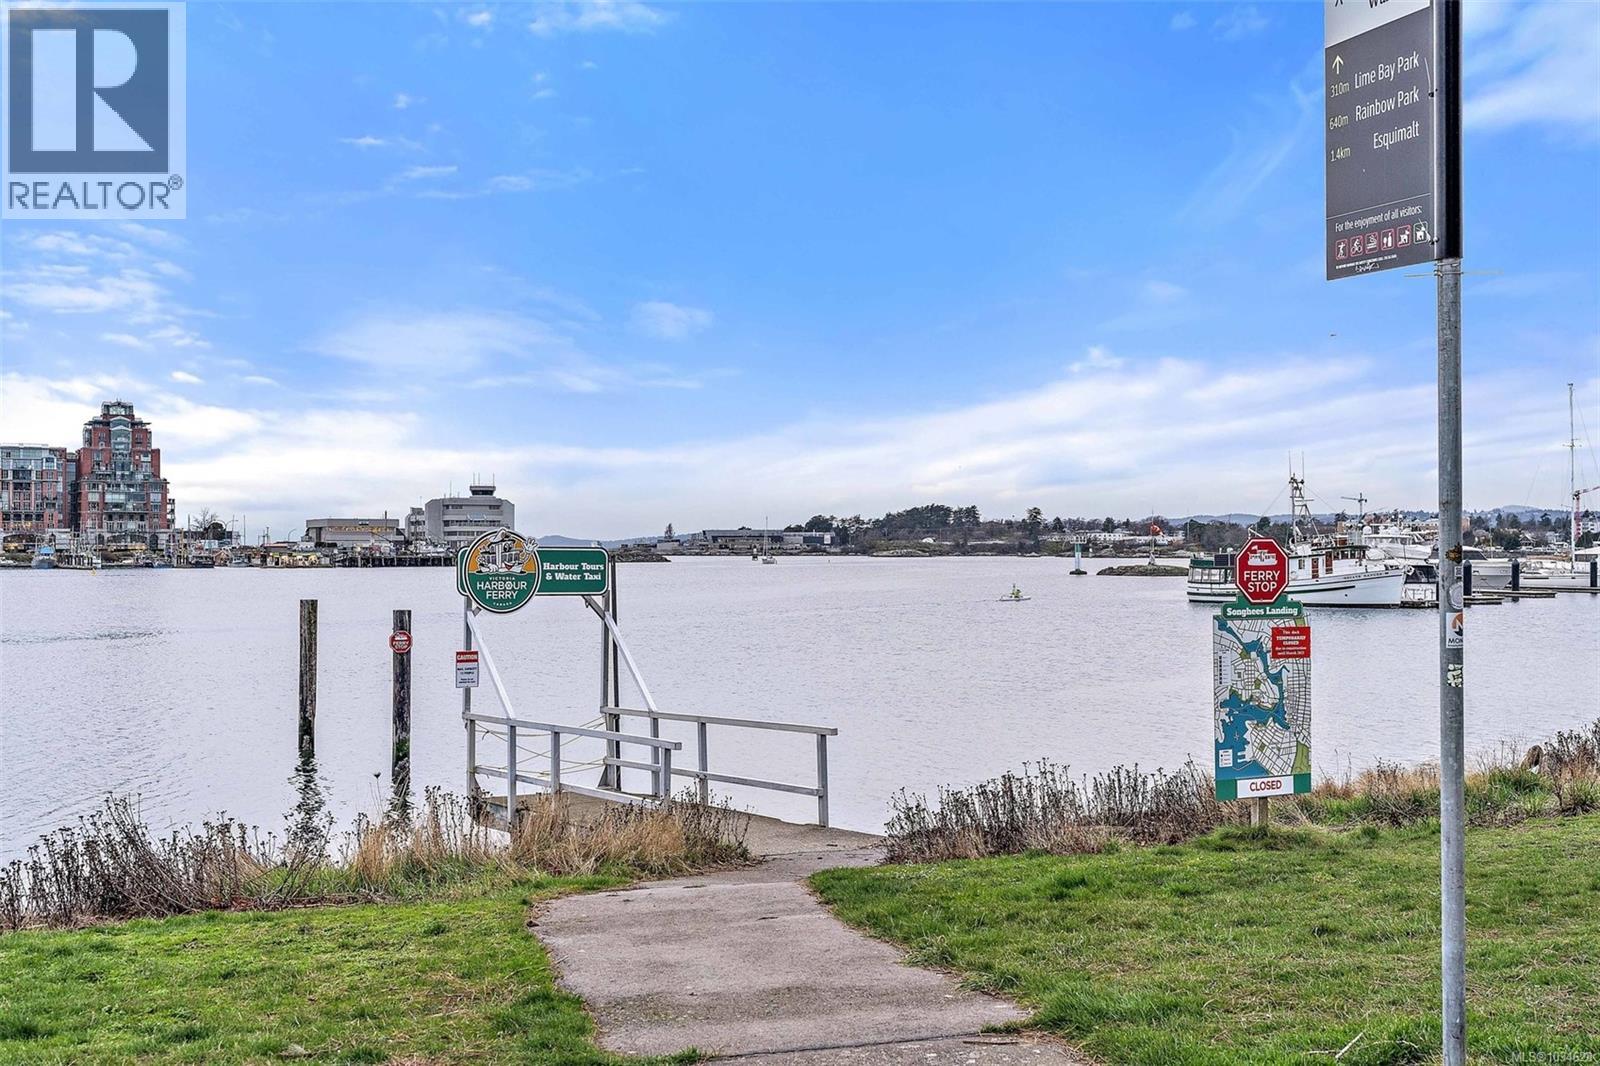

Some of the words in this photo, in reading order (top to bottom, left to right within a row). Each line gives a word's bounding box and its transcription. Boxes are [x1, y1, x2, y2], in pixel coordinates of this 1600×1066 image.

[1354, 70, 1376, 89] Lime
[1378, 63, 1396, 82] Bay
[1397, 51, 1420, 74] Park
[1330, 82, 1350, 98] 310m
[1355, 98, 1396, 122] Rainbow
[1397, 86, 1420, 108] Park
[1329, 115, 1349, 130] 640m
[1373, 121, 1420, 150] Esquimalt
[1330, 147, 1351, 162] 1.4km
[1335, 222, 1344, 232] For
[1344, 219, 1354, 230] the
[1354, 213, 1384, 230] enjoyment
[1384, 209, 1391, 221] of
[1391, 208, 1399, 220] all
[543, 562, 579, 570] Harbour
[581, 562, 604, 570] Tours
[545, 572, 552, 580] &
[555, 572, 581, 580] Water
[583, 572, 601, 580] Taxi
[1243, 570, 1280, 581] FERRY
[476, 581, 527, 590] HARBOUR
[1247, 582, 1277, 593] STOP
[486, 591, 518, 600] FERRY
[1226, 606, 1264, 617] Songhees
[1266, 606, 1298, 615] Landing
[1250, 780, 1282, 791] CLOSED
